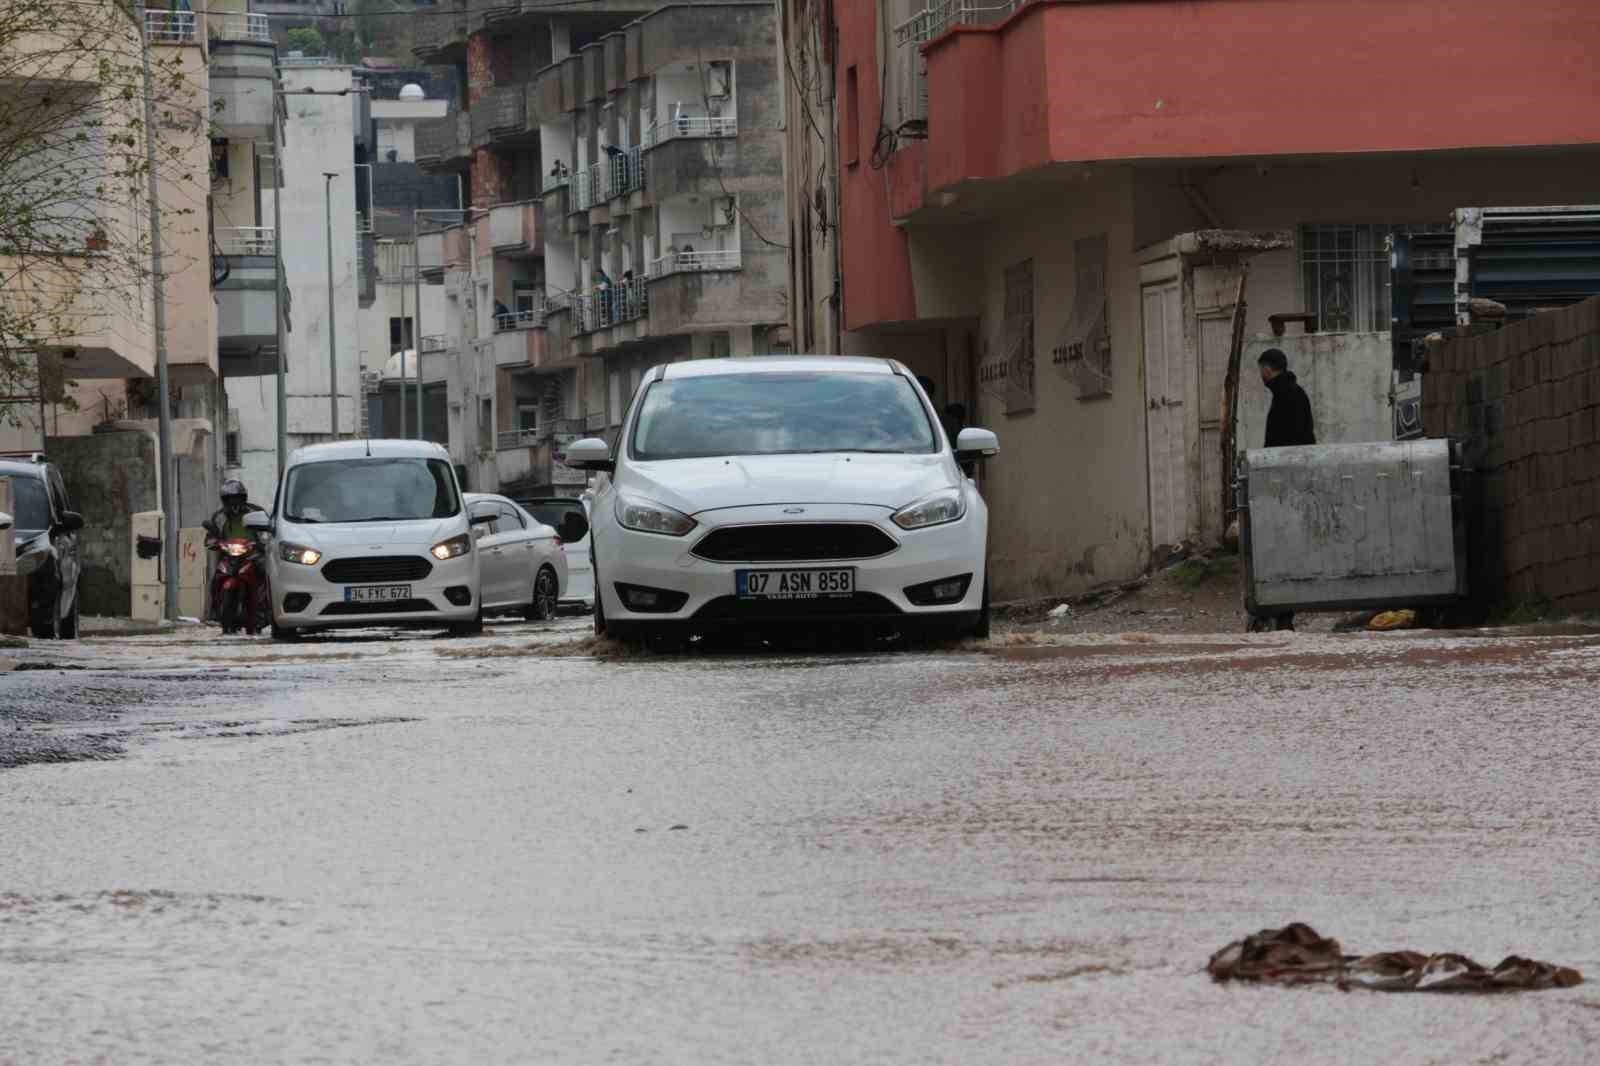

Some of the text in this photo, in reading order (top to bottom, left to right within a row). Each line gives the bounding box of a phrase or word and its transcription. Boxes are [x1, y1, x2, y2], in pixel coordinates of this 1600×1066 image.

[749, 571, 849, 593] 07 ASN 858
